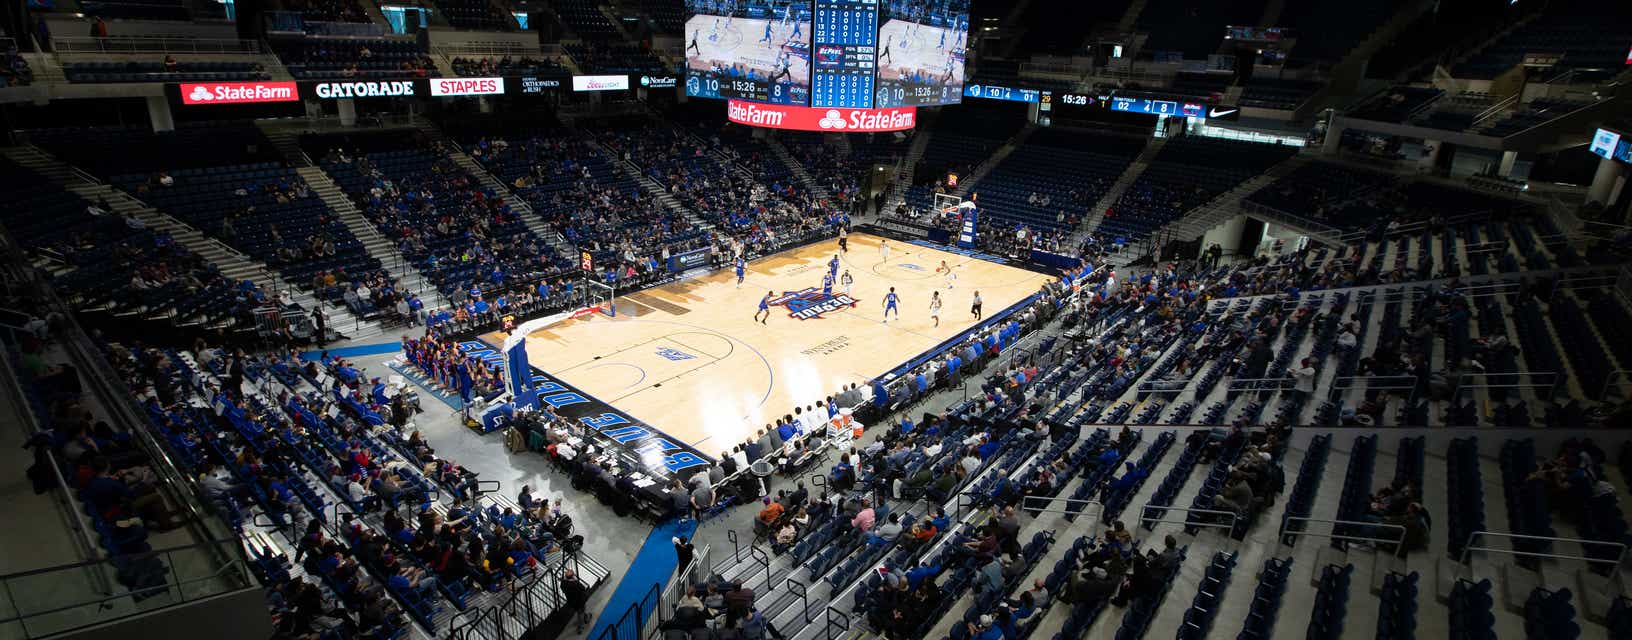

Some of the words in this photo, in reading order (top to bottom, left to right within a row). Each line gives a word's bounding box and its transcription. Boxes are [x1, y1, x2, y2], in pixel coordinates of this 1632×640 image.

[316, 81, 414, 98] GATORADE
[440, 80, 496, 94] STAPLES
[706, 80, 718, 91] 10
[732, 81, 756, 92] 15:26
[775, 84, 781, 96] 8
[895, 88, 904, 100] 10
[943, 87, 948, 98] 8
[990, 88, 999, 97] 10
[1062, 94, 1086, 105] 15:26
[1118, 102, 1129, 110] 02
[1144, 104, 1150, 112] 4
[1160, 104, 1168, 112] 8
[790, 295, 857, 320] DEPAUL
